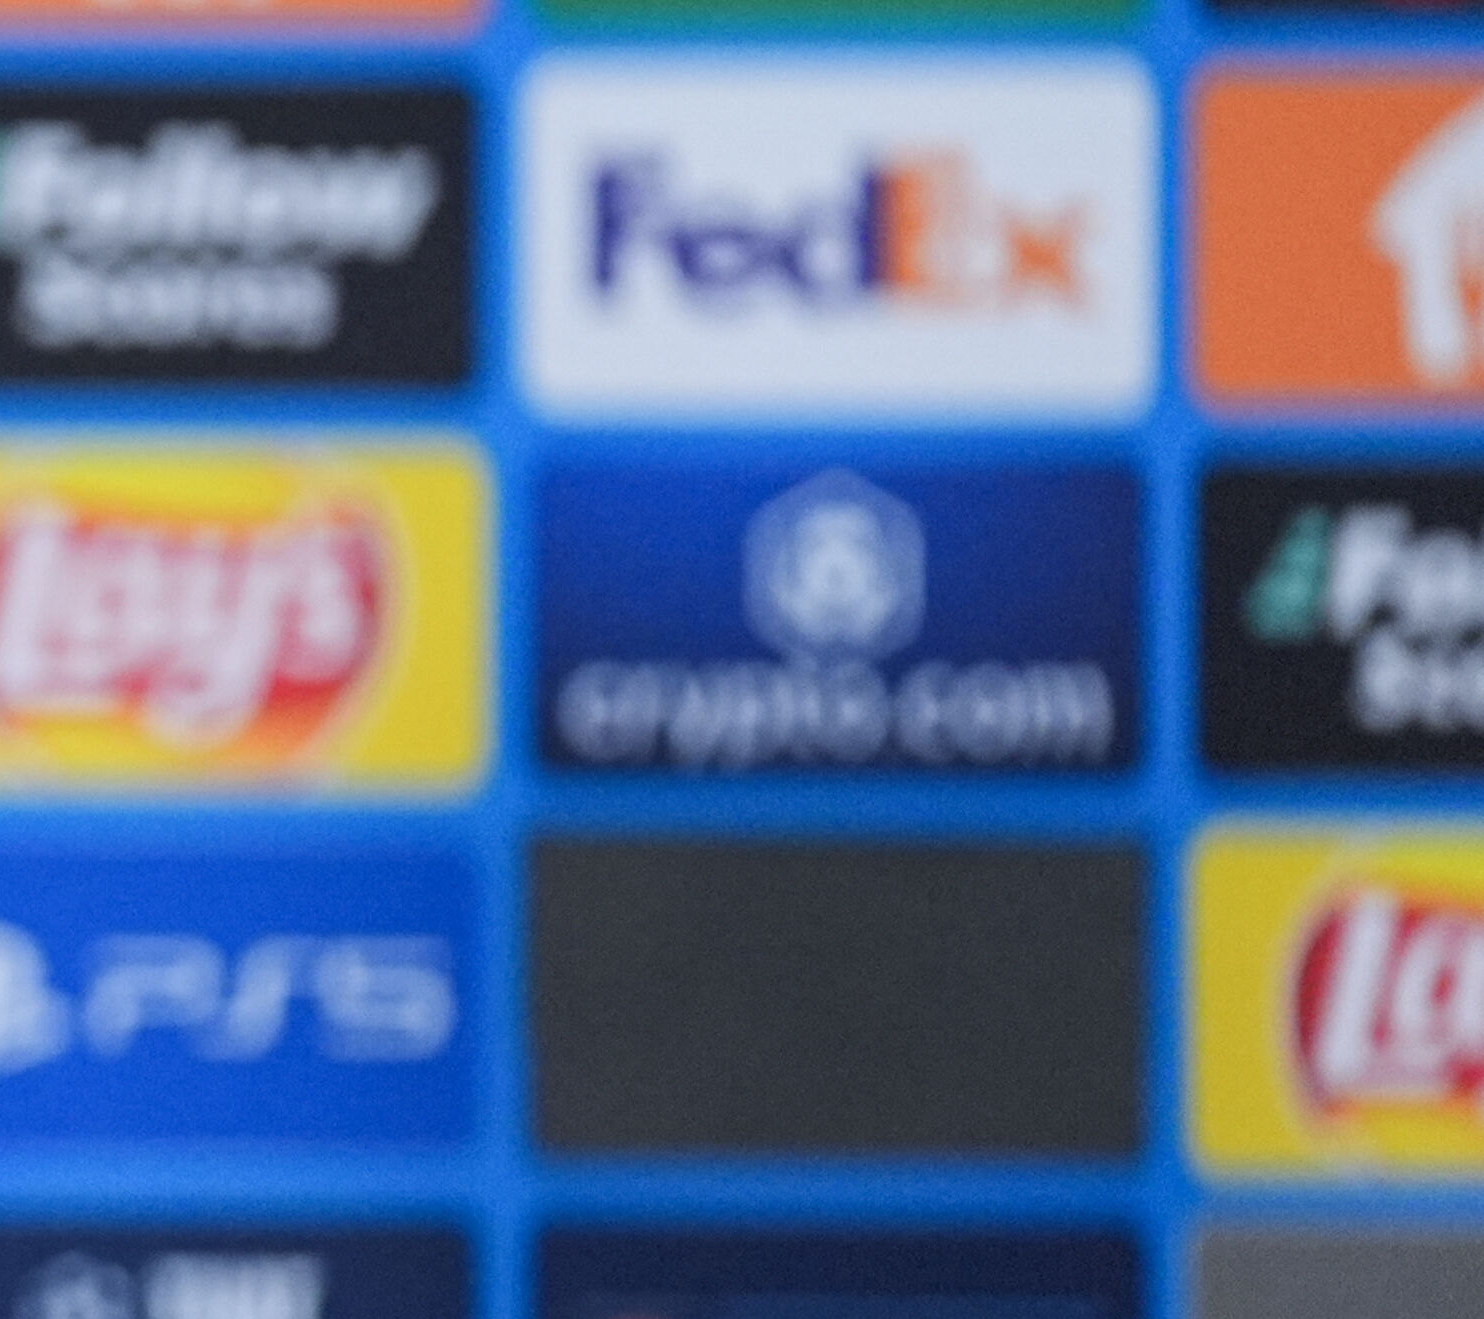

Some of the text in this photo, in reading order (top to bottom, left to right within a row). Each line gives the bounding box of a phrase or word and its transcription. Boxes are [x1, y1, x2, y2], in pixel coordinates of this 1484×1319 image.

[584, 145, 1094, 320] FedEx
[20, 260, 338, 348] Scores
[556, 660, 1114, 772] crypto.com
[81, 932, 460, 1063] PS5
